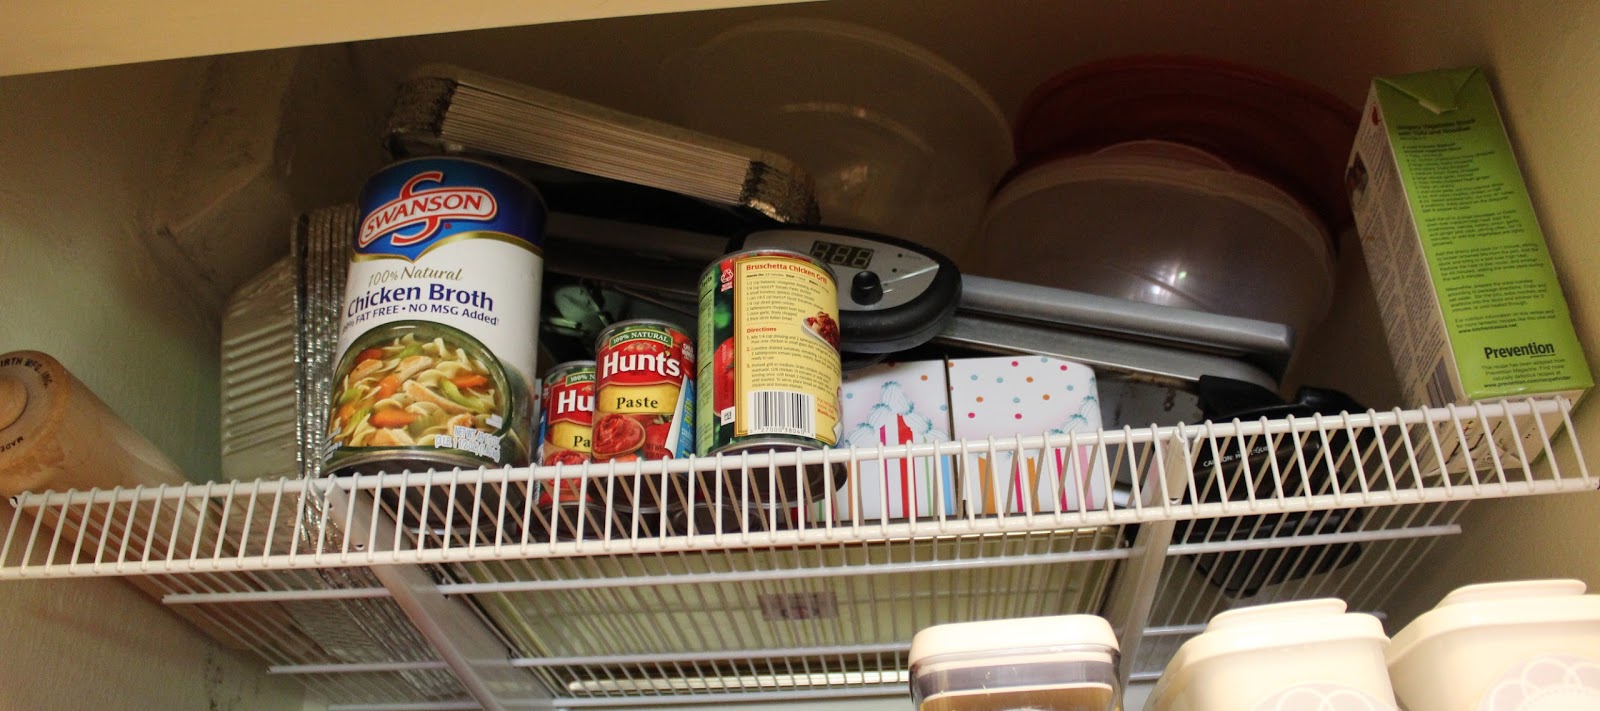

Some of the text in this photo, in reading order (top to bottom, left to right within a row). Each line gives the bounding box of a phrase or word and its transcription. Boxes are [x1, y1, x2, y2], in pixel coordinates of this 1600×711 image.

[365, 194, 482, 238] SWANSON
[368, 266, 463, 287] 100% Natural
[789, 265, 816, 278] Chicken
[817, 273, 828, 284] Grill
[348, 284, 493, 318] Chicken Broth
[356, 311, 371, 325] FAT
[373, 305, 398, 318] FREE
[408, 304, 428, 313] NO
[430, 304, 458, 316] MSG
[613, 332, 668, 344] 100% NATURAL
[1484, 342, 1554, 359] Prevention
[602, 350, 680, 379] Hunt's
[570, 374, 588, 382] 100%
[616, 397, 658, 410] Paste
